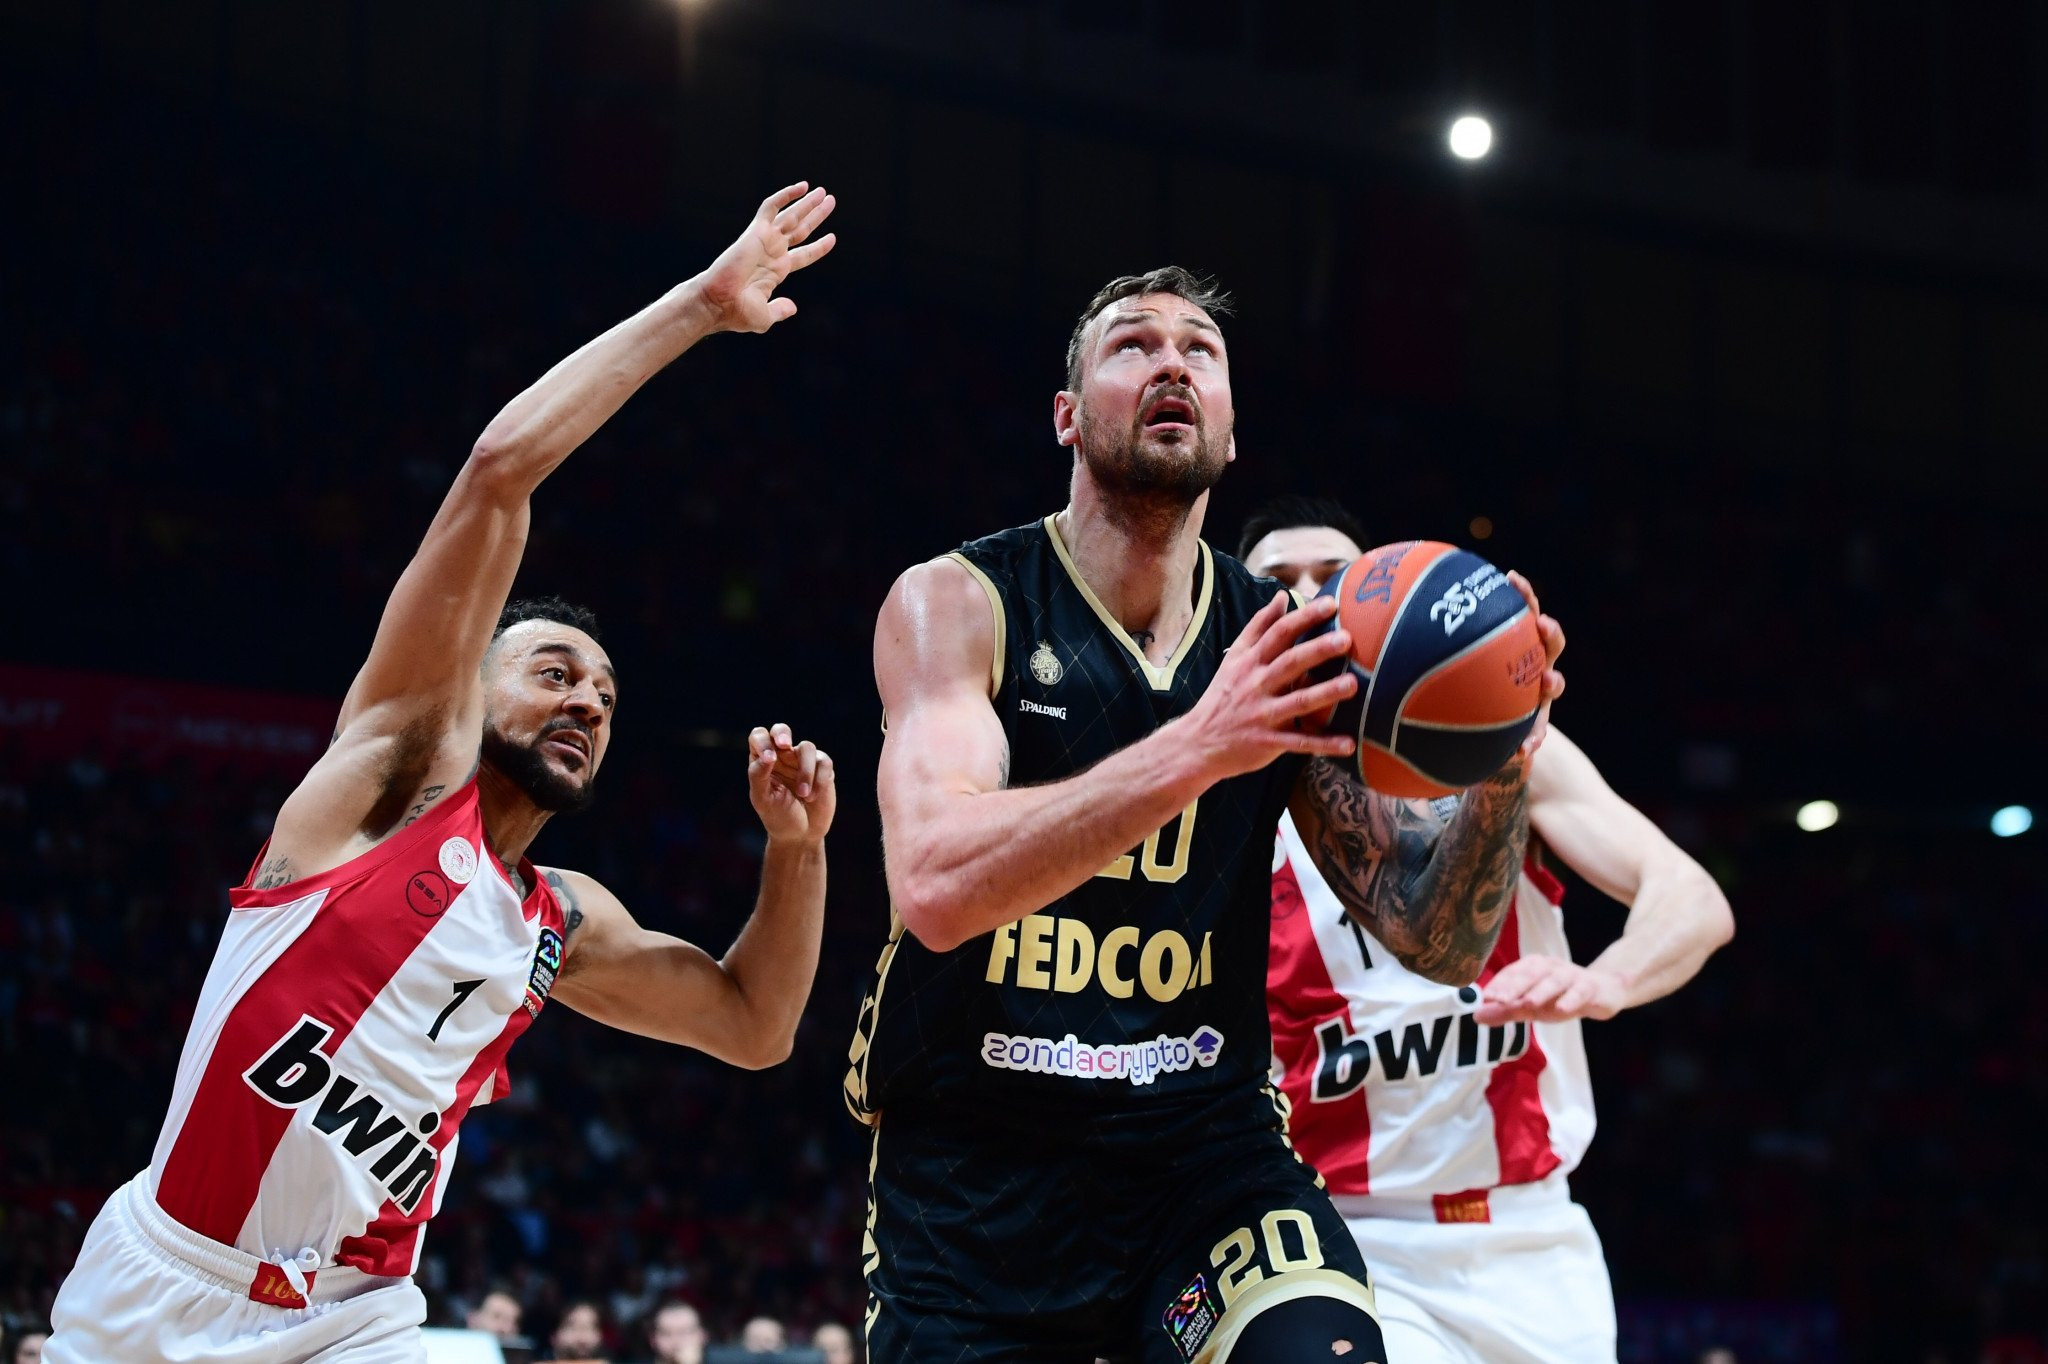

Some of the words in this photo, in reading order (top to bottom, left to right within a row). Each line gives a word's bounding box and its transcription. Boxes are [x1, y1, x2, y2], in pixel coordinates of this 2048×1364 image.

[1430, 581, 1477, 637] 25
[1019, 699, 1067, 720] SPALDING
[1094, 797, 1198, 883] 0
[426, 978, 488, 1043] 1
[987, 1038, 1190, 1079] zondacrypto
[1316, 986, 1526, 1098] bwin
[246, 1018, 440, 1213] bwin
[1209, 1209, 1325, 1309] 20
[1181, 1305, 1207, 1344] TURKISH
[1185, 1313, 1211, 1352] AIRLINES
